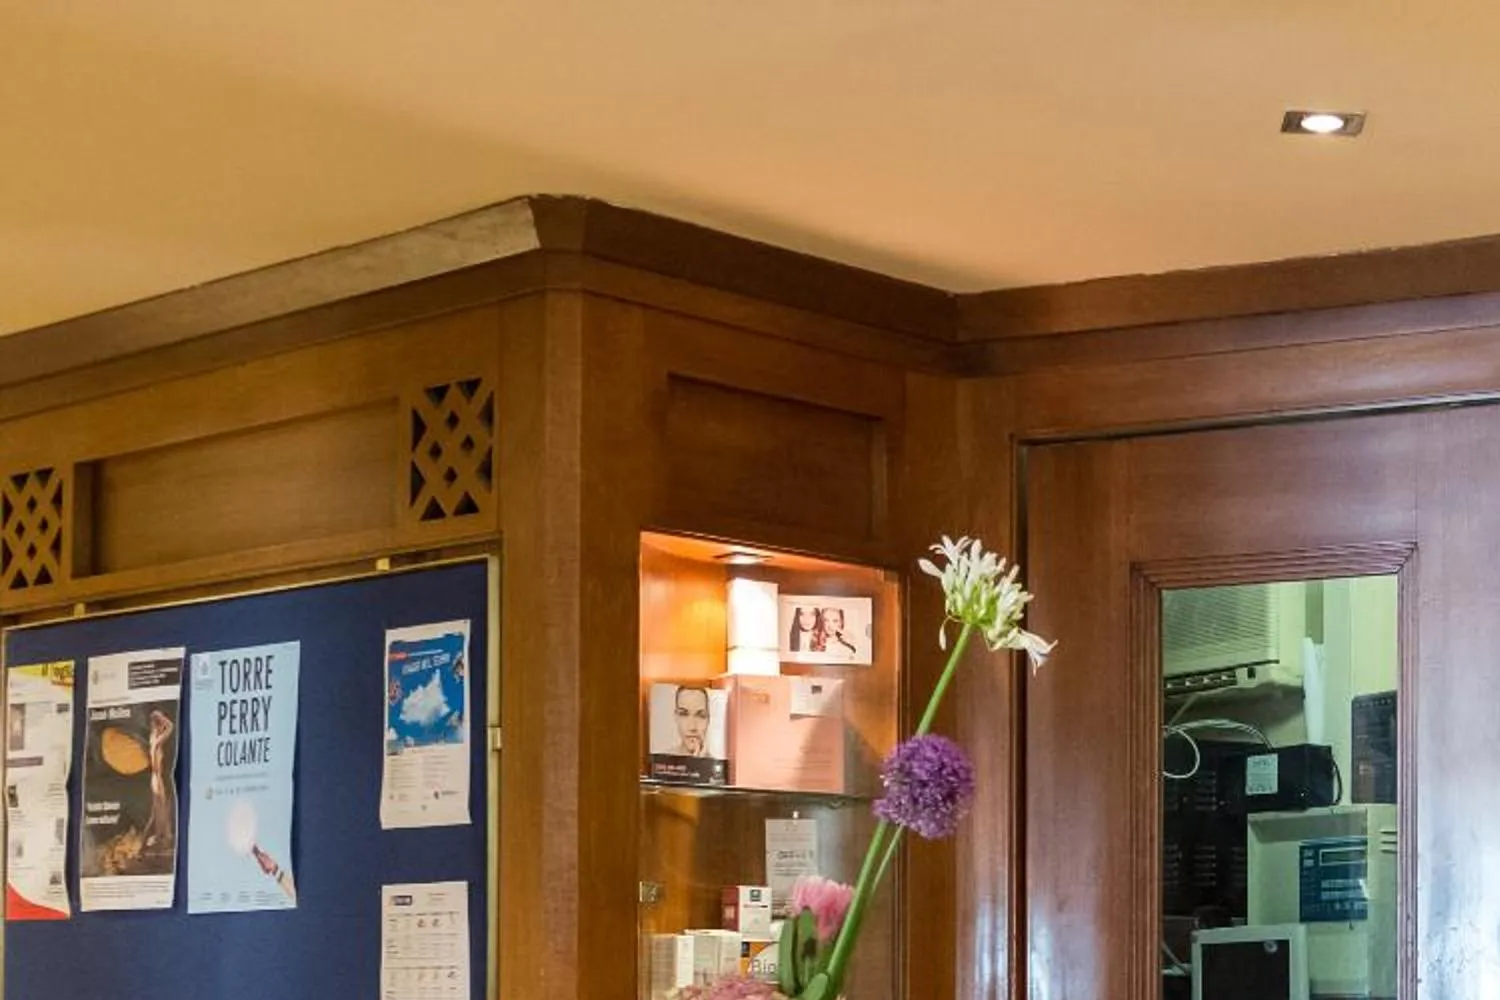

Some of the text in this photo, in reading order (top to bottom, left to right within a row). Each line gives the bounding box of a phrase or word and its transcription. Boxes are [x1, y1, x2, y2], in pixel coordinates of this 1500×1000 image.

[218, 655, 274, 695] TORRE
[217, 696, 272, 736] PERRY
[217, 737, 271, 767] COLANTE
